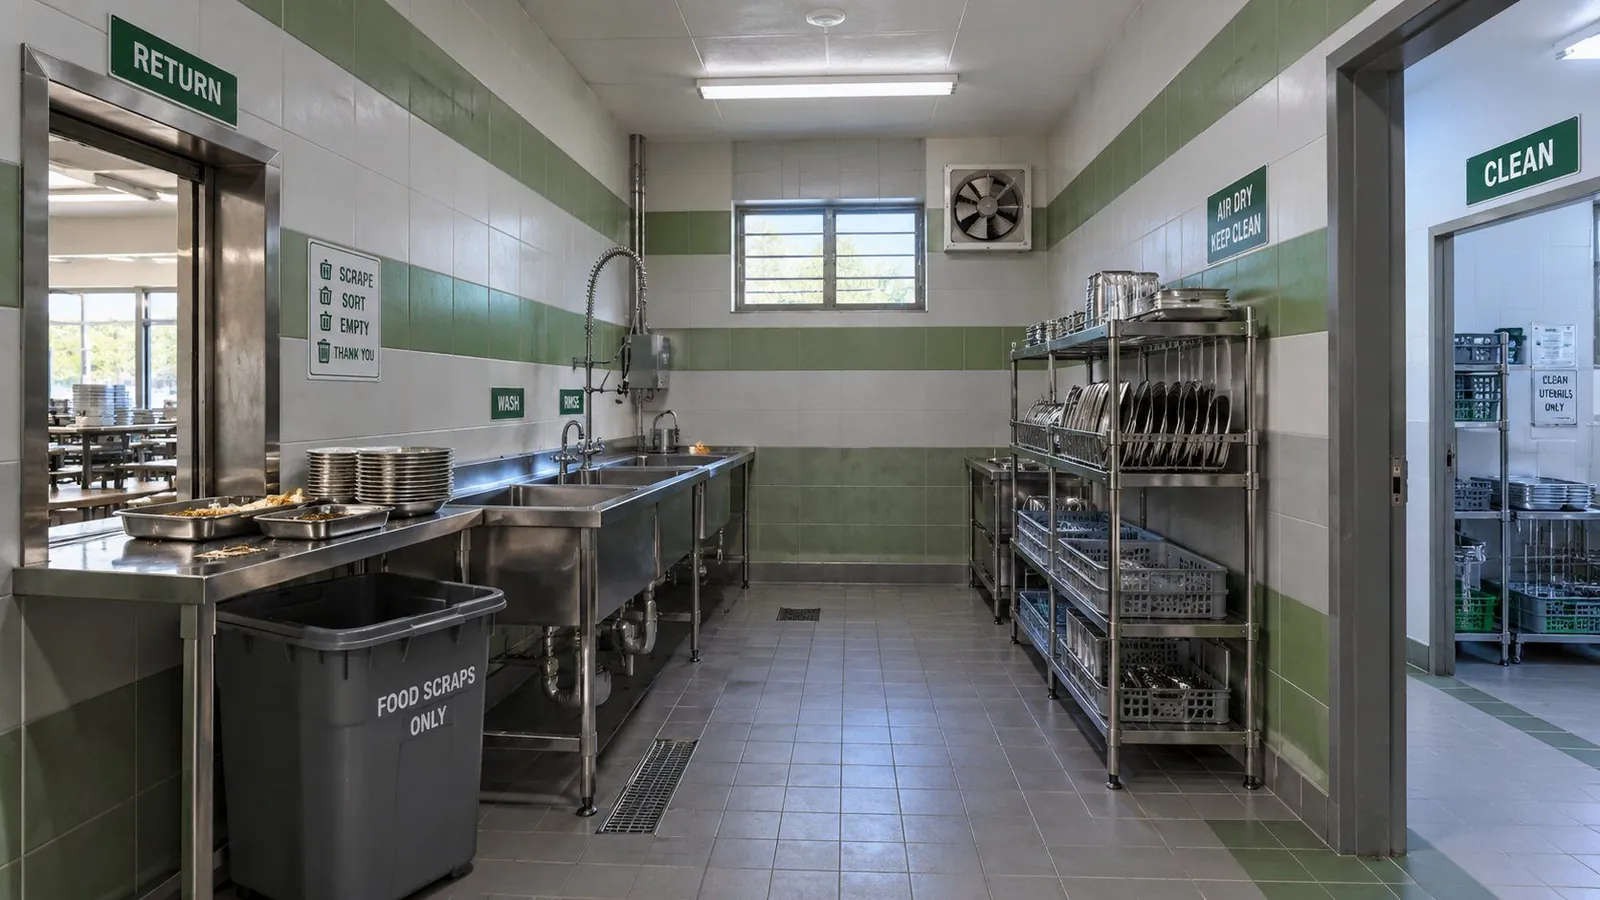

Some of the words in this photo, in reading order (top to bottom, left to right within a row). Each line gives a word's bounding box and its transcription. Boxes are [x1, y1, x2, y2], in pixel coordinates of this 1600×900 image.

[133, 41, 221, 106] RETURN
[1484, 138, 1554, 188] CLEAN
[1217, 197, 1231, 222] AIR
[1234, 184, 1253, 213] DRY
[1211, 227, 1231, 253] KEEP
[1232, 213, 1261, 243] CLEAN
[339, 266, 374, 288] SCRAPE
[342, 292, 366, 311] SORT
[340, 317, 370, 336] EMPTY
[334, 345, 359, 361] THANK
[360, 348, 375, 361] YOU
[1542, 375, 1569, 385] CLEAN
[497, 395, 520, 412] WASH
[377, 685, 420, 717] FOOD
[423, 666, 476, 701] SCRAPS
[409, 705, 448, 737] ONLY
